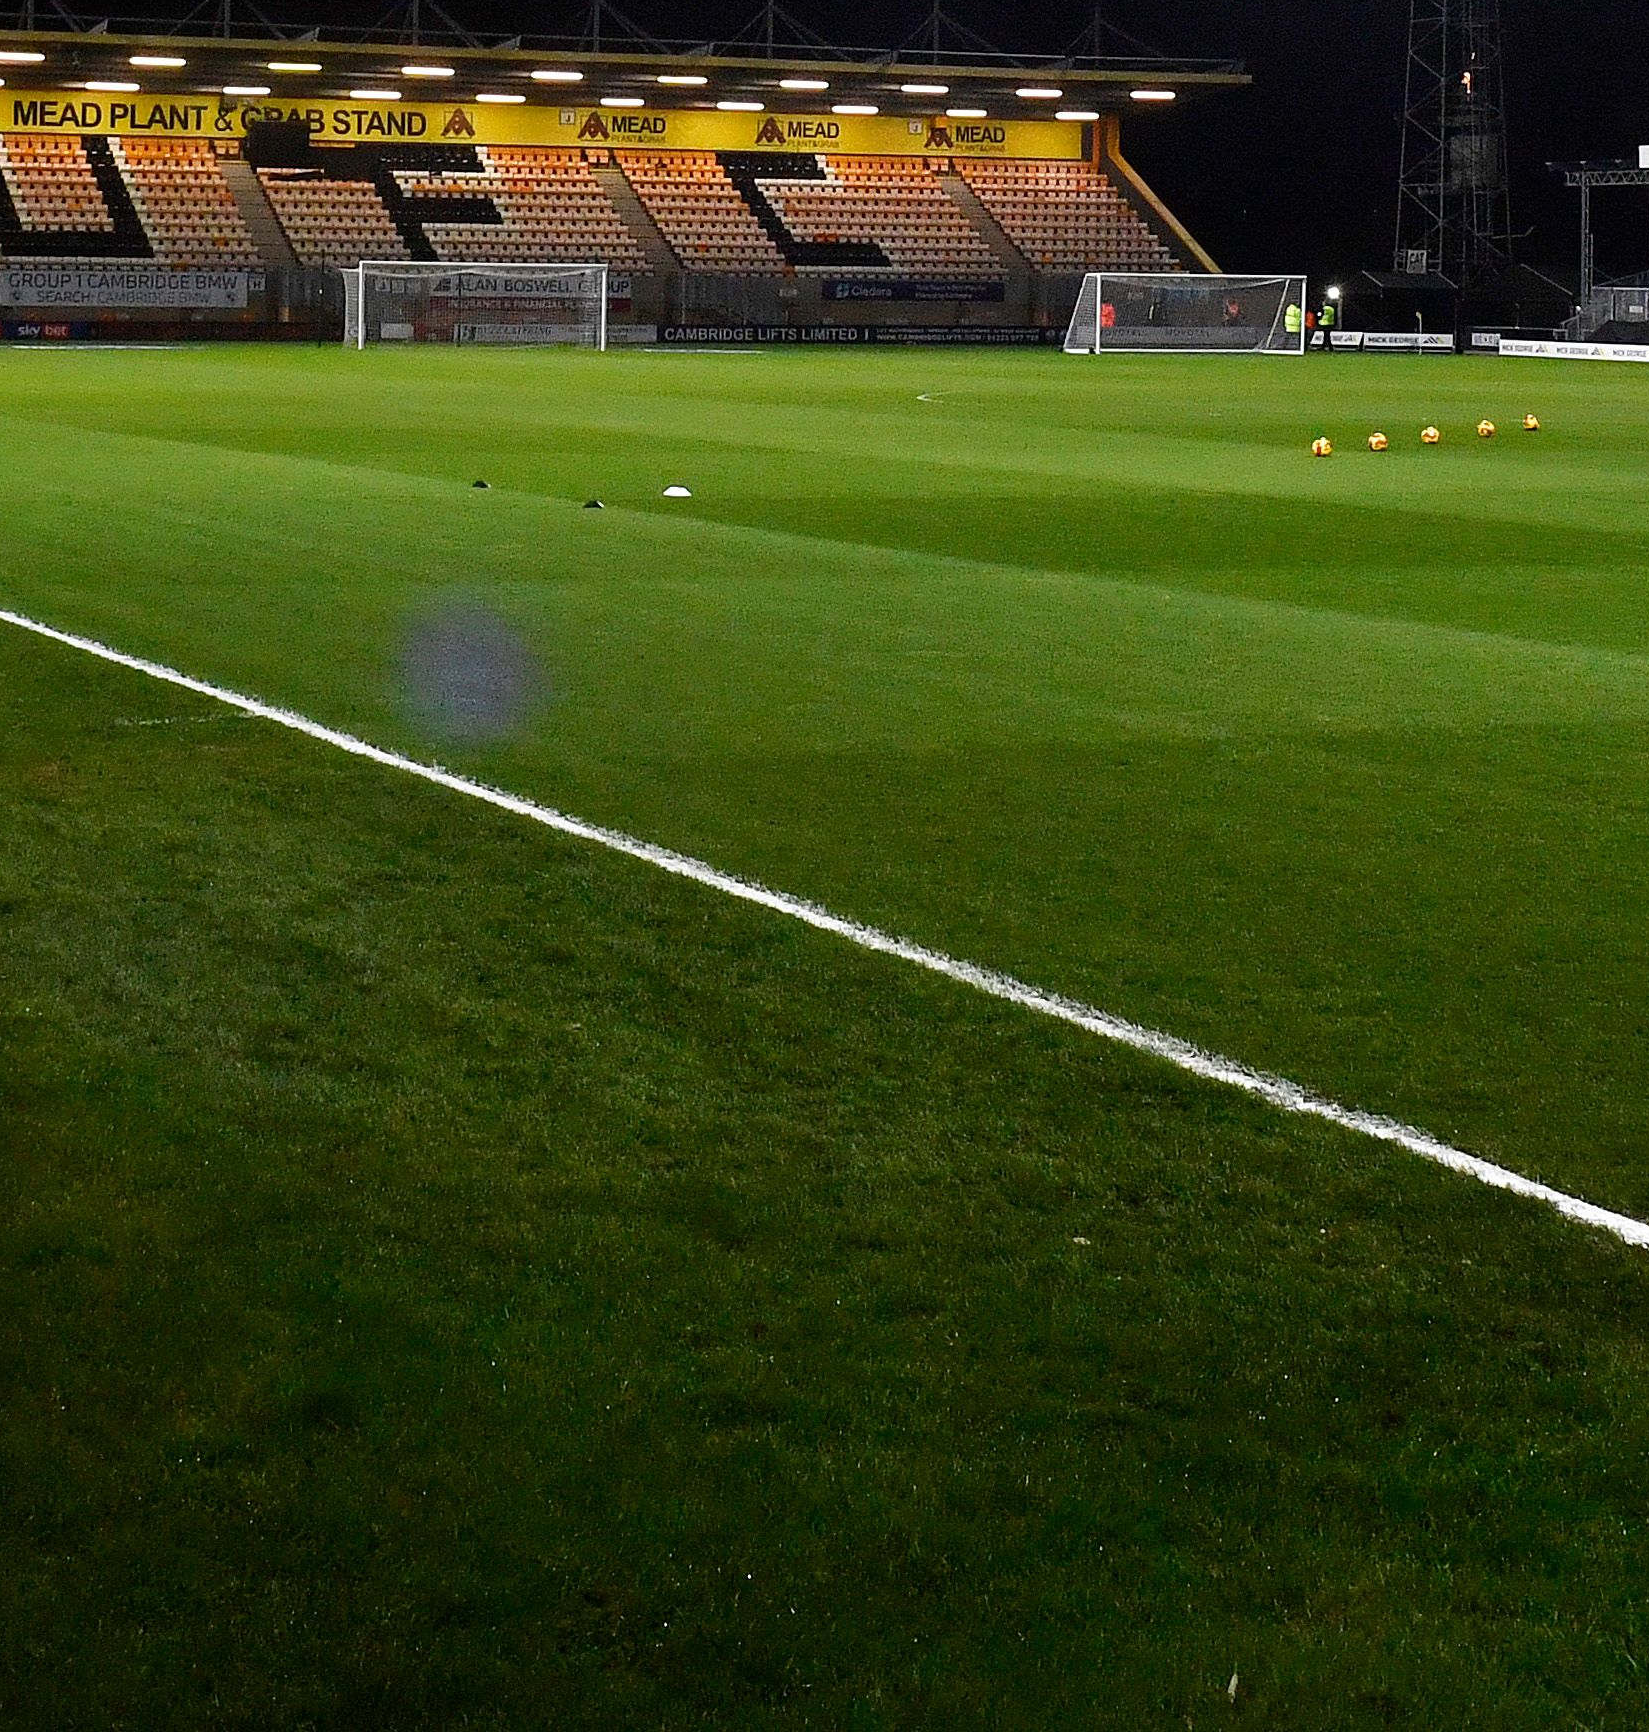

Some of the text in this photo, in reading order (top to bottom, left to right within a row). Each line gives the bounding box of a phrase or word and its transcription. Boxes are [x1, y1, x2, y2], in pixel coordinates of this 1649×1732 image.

[13, 100, 102, 127] MEAD
[110, 103, 208, 130] PLANT
[215, 105, 233, 132] &
[332, 110, 426, 136] STAND
[612, 116, 666, 133] MEAD
[787, 121, 840, 139] MEAD
[956, 126, 1005, 143] MEAD
[716, 153, 892, 266] C
[9, 273, 237, 290] GROUP 1 CAMBRIDGE BMW
[504, 278, 572, 293] BOSWELL
[18, 324, 68, 338] sky bet
[665, 328, 754, 341] CAMBRIDGE
[758, 328, 797, 341] LIFTS
[801, 328, 858, 341] LIMITED
